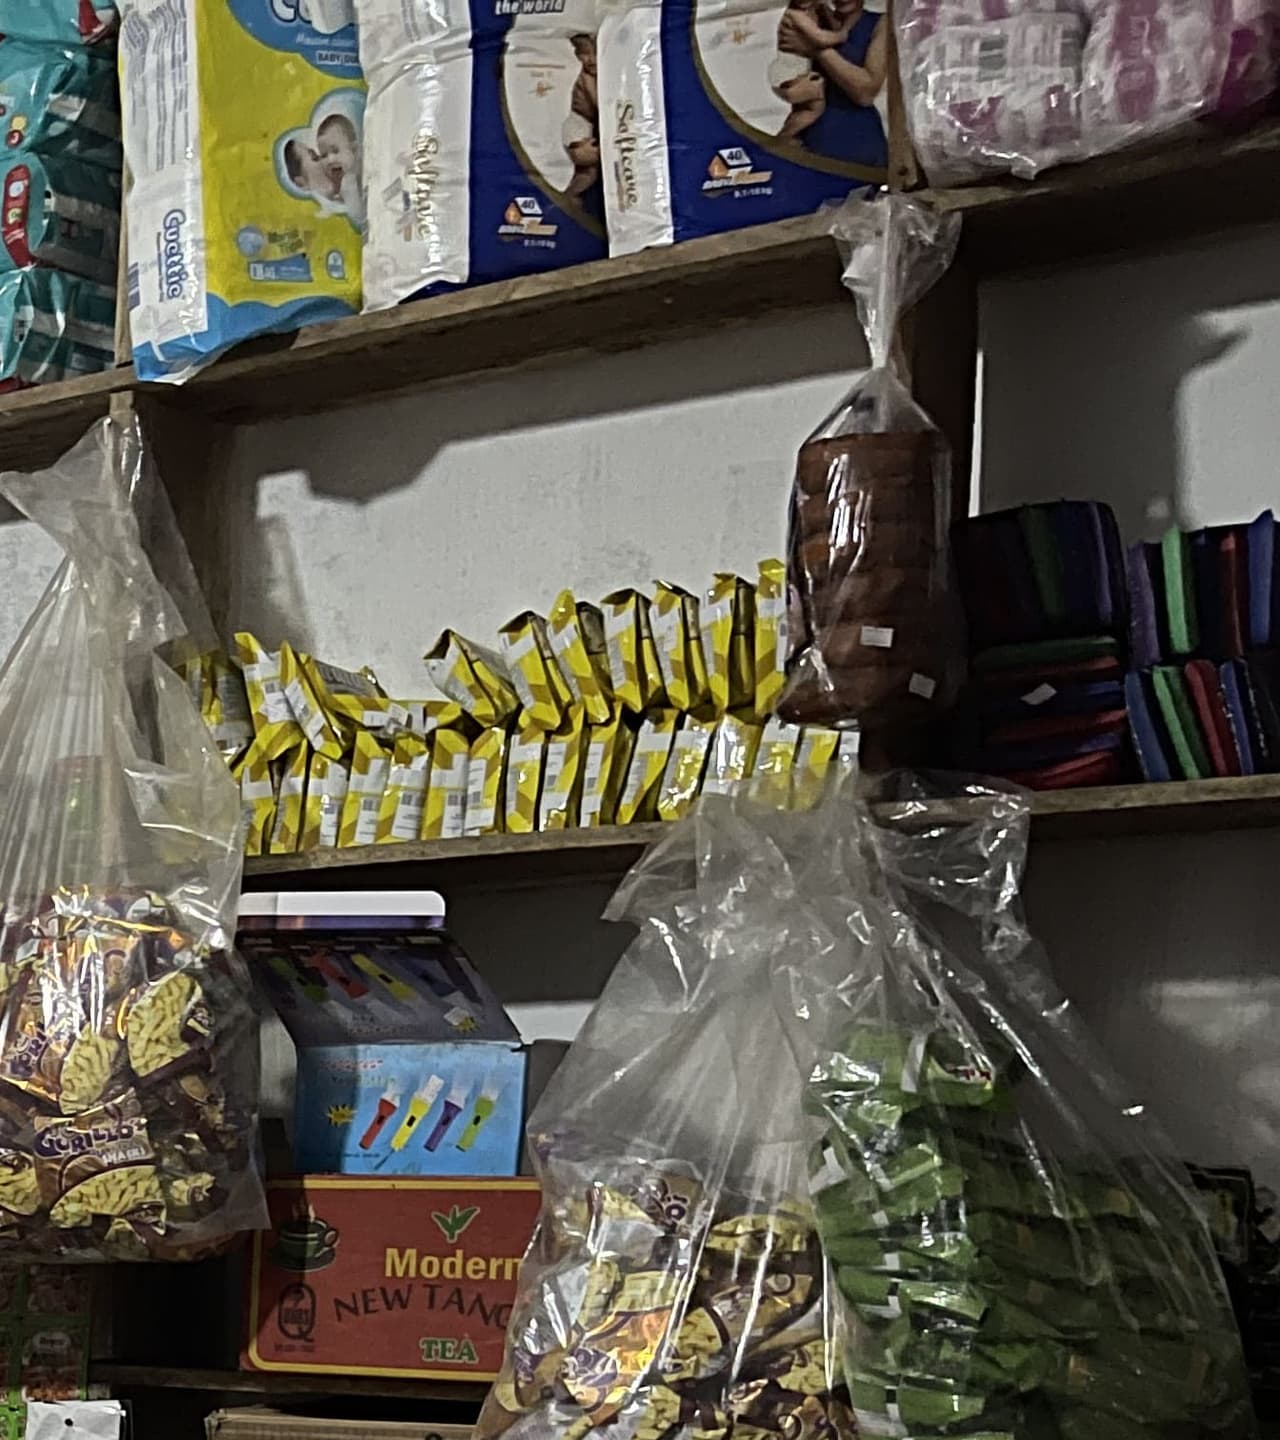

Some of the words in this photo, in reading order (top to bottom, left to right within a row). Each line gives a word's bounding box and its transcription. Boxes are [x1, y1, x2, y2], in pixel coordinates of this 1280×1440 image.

[726, 150, 741, 161] 40
[521, 198, 536, 210] 40
[384, 1247, 521, 1282] Modern
[332, 1287, 408, 1323] NEW
[421, 1338, 477, 1363] TEA
